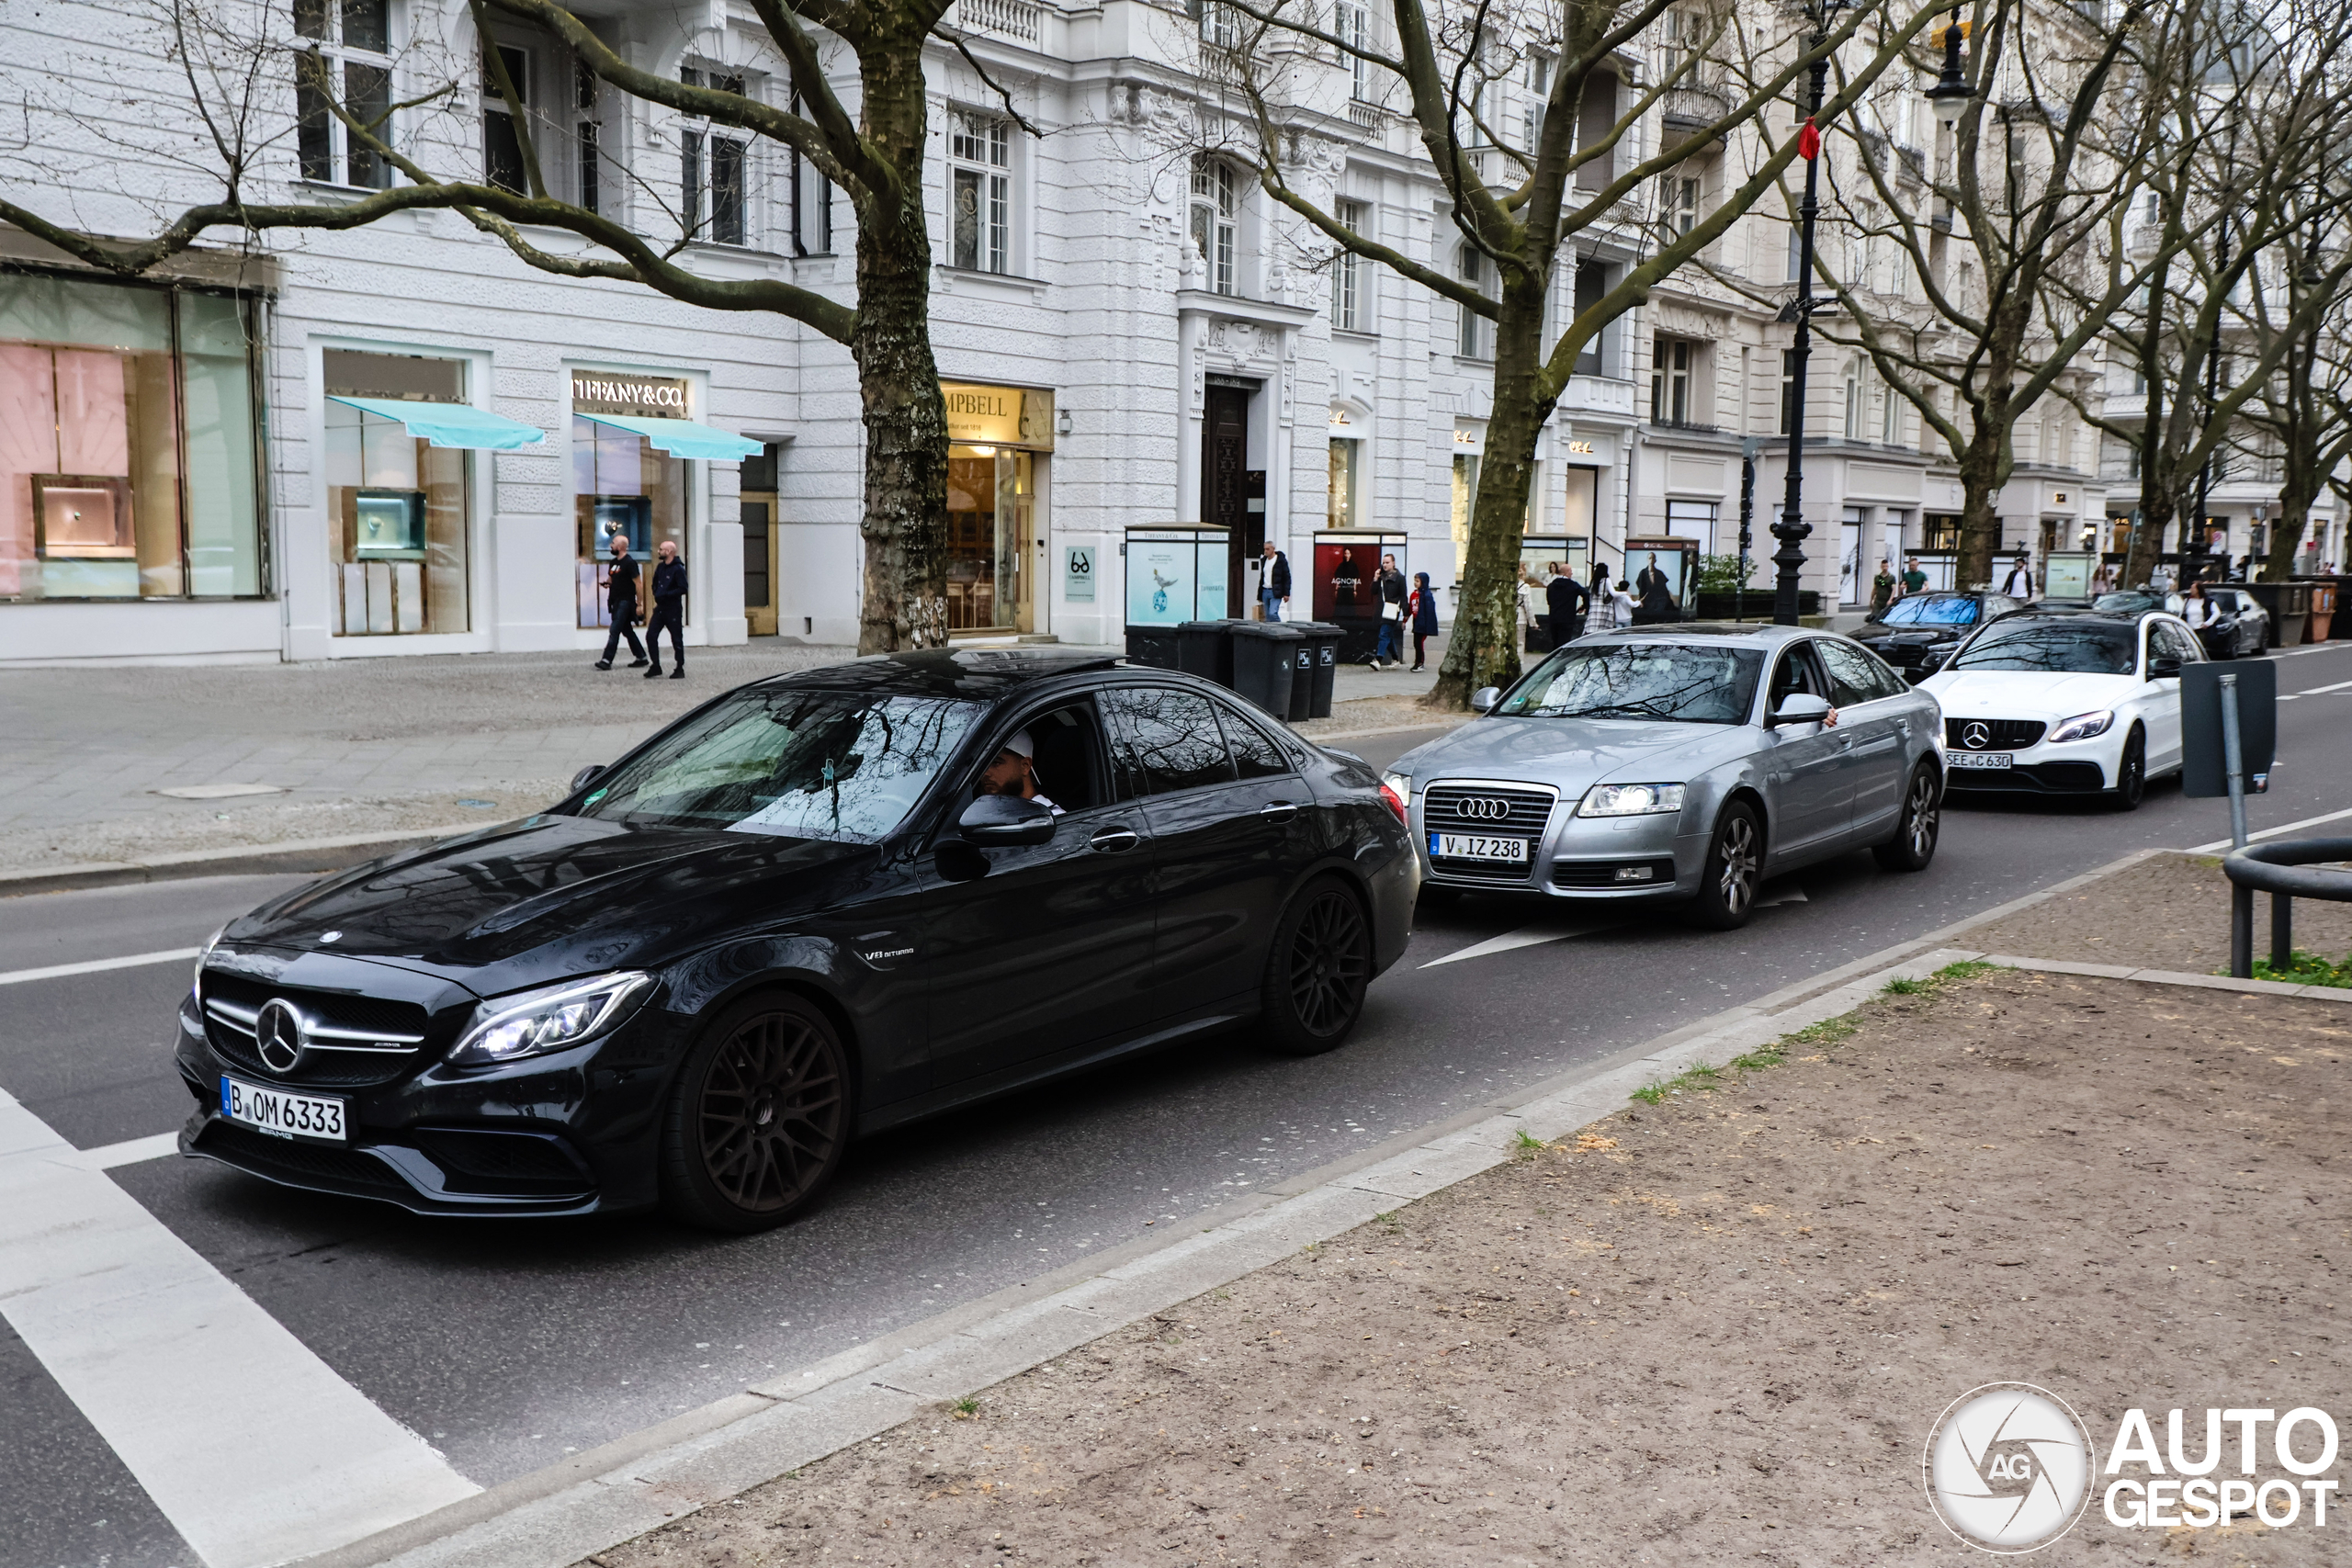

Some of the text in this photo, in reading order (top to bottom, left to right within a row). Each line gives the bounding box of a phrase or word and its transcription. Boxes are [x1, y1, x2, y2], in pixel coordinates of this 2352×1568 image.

[1330, 577, 1362, 585] AGNONA
[1947, 753, 2010, 768] SEE C 630
[1445, 837, 1521, 858] V IZ 238
[865, 951, 883, 961] V8
[232, 1085, 342, 1134] B OM 6333
